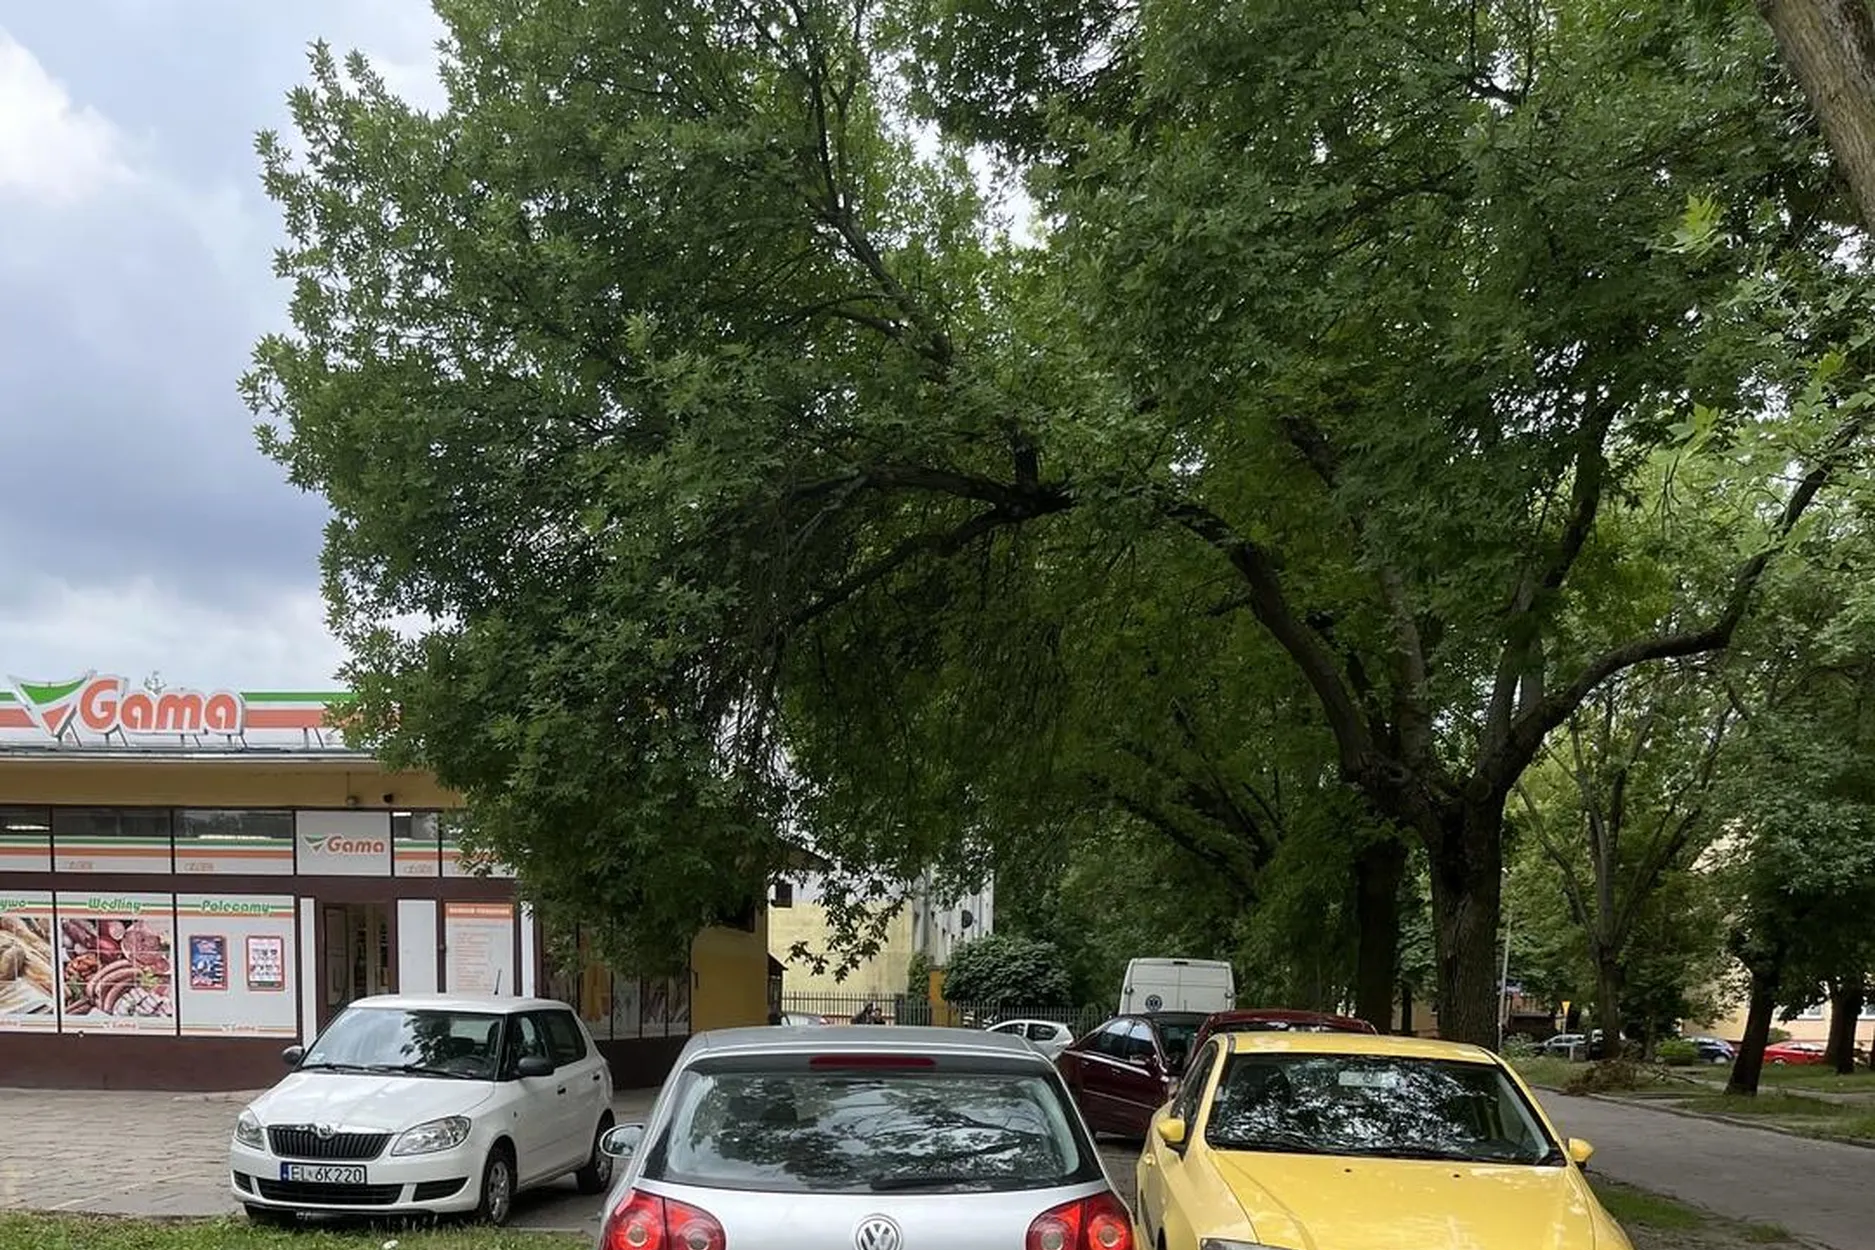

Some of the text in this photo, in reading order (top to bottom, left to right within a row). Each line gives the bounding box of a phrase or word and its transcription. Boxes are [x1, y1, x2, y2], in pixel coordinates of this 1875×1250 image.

[79, 678, 238, 730] Gama
[327, 836, 385, 854] Gama
[202, 899, 271, 914] Polecamy
[291, 1166, 308, 1181] EL
